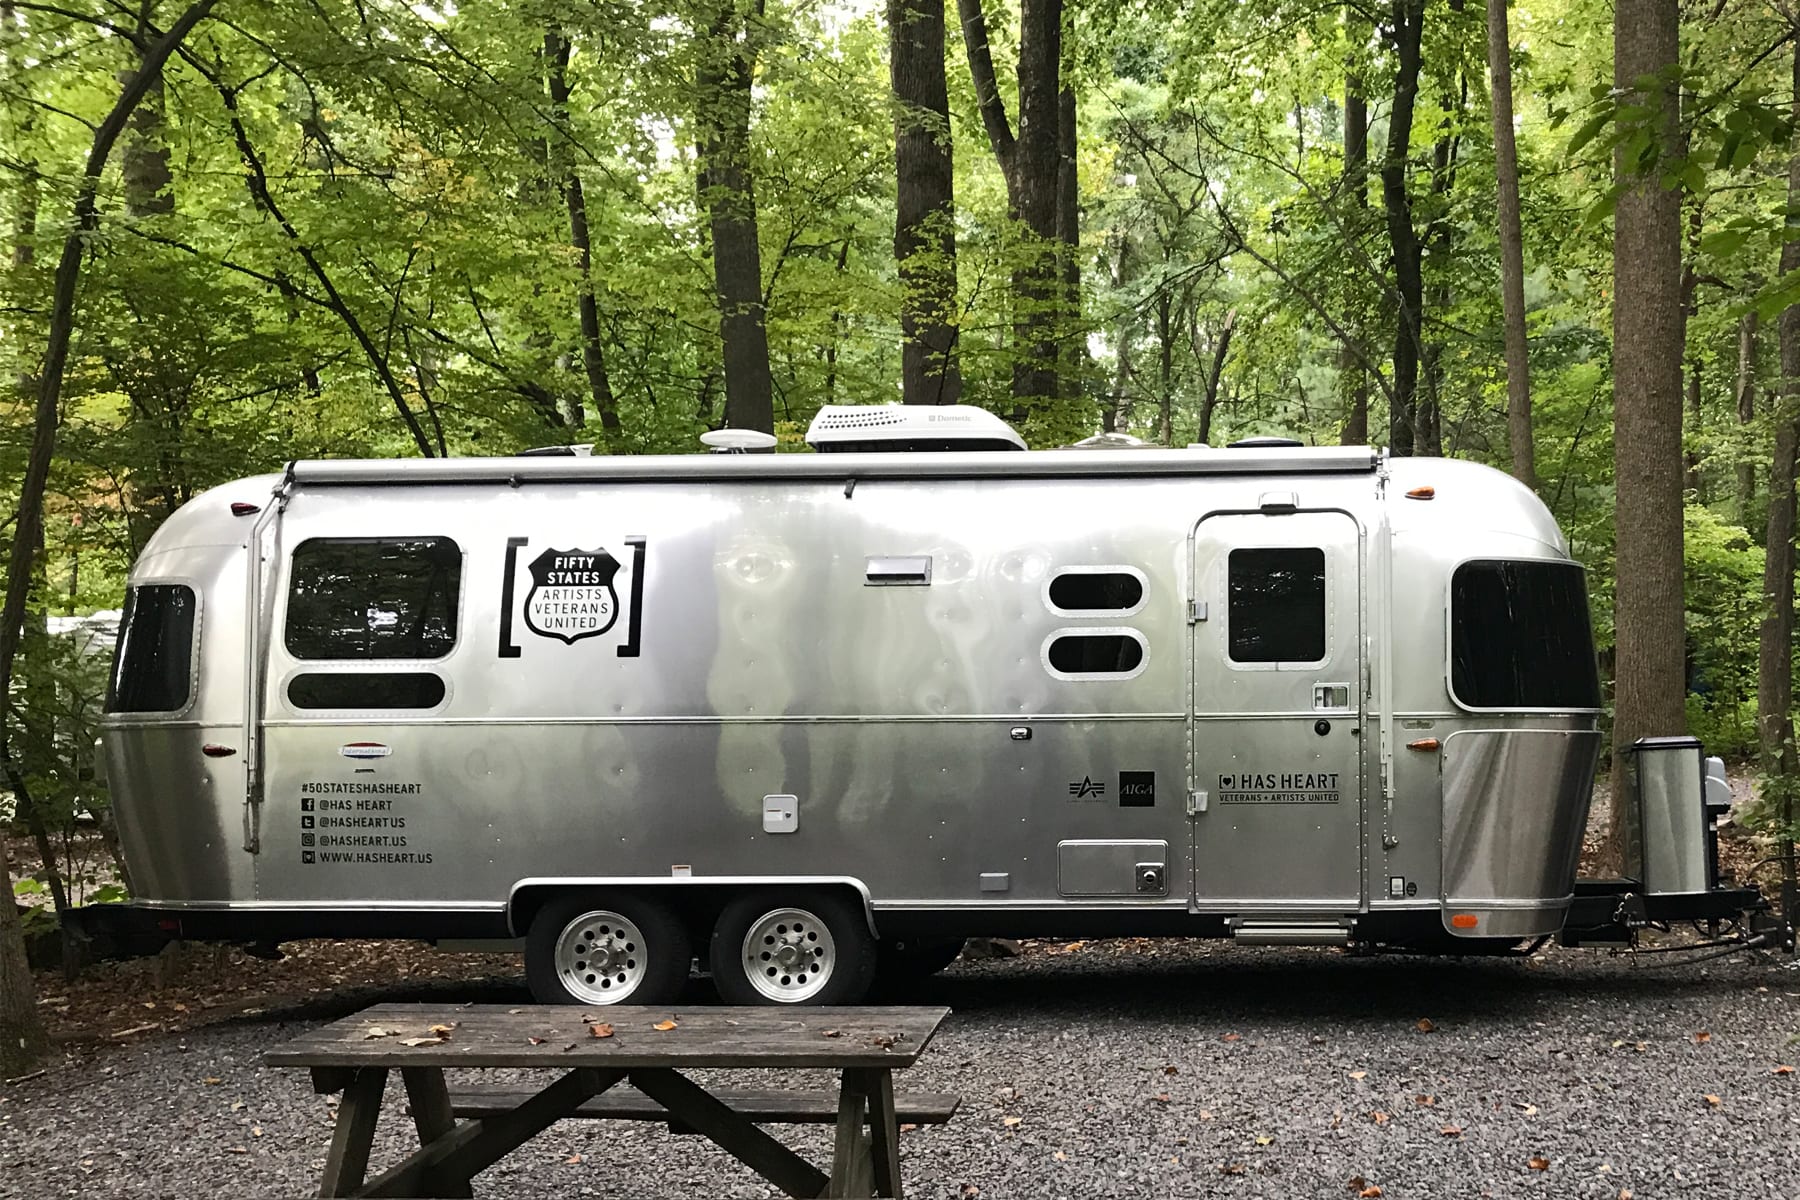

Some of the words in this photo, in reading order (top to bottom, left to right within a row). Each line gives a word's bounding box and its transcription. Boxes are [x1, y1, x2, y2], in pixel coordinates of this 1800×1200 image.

[555, 557, 595, 569] FIFTY
[548, 572, 599, 584] STATES
[543, 589, 602, 600] ARTISTS
[535, 602, 608, 615] VETERANS
[545, 617, 597, 628] UNITED
[1241, 774, 1276, 789] HAS
[1281, 773, 1339, 789] HEART
[301, 782, 422, 795] #50STATESHASHEART
[1120, 783, 1153, 795] AIGA
[1219, 794, 1262, 802] VETERANS
[1270, 793, 1306, 802] ARTISTS
[1308, 793, 1339, 802] UNITED
[319, 800, 352, 811] @HAS
[356, 800, 393, 811] HEART
[319, 835, 407, 847] @HASHEART.US
[320, 852, 433, 864] WWW.HASHEART.US
